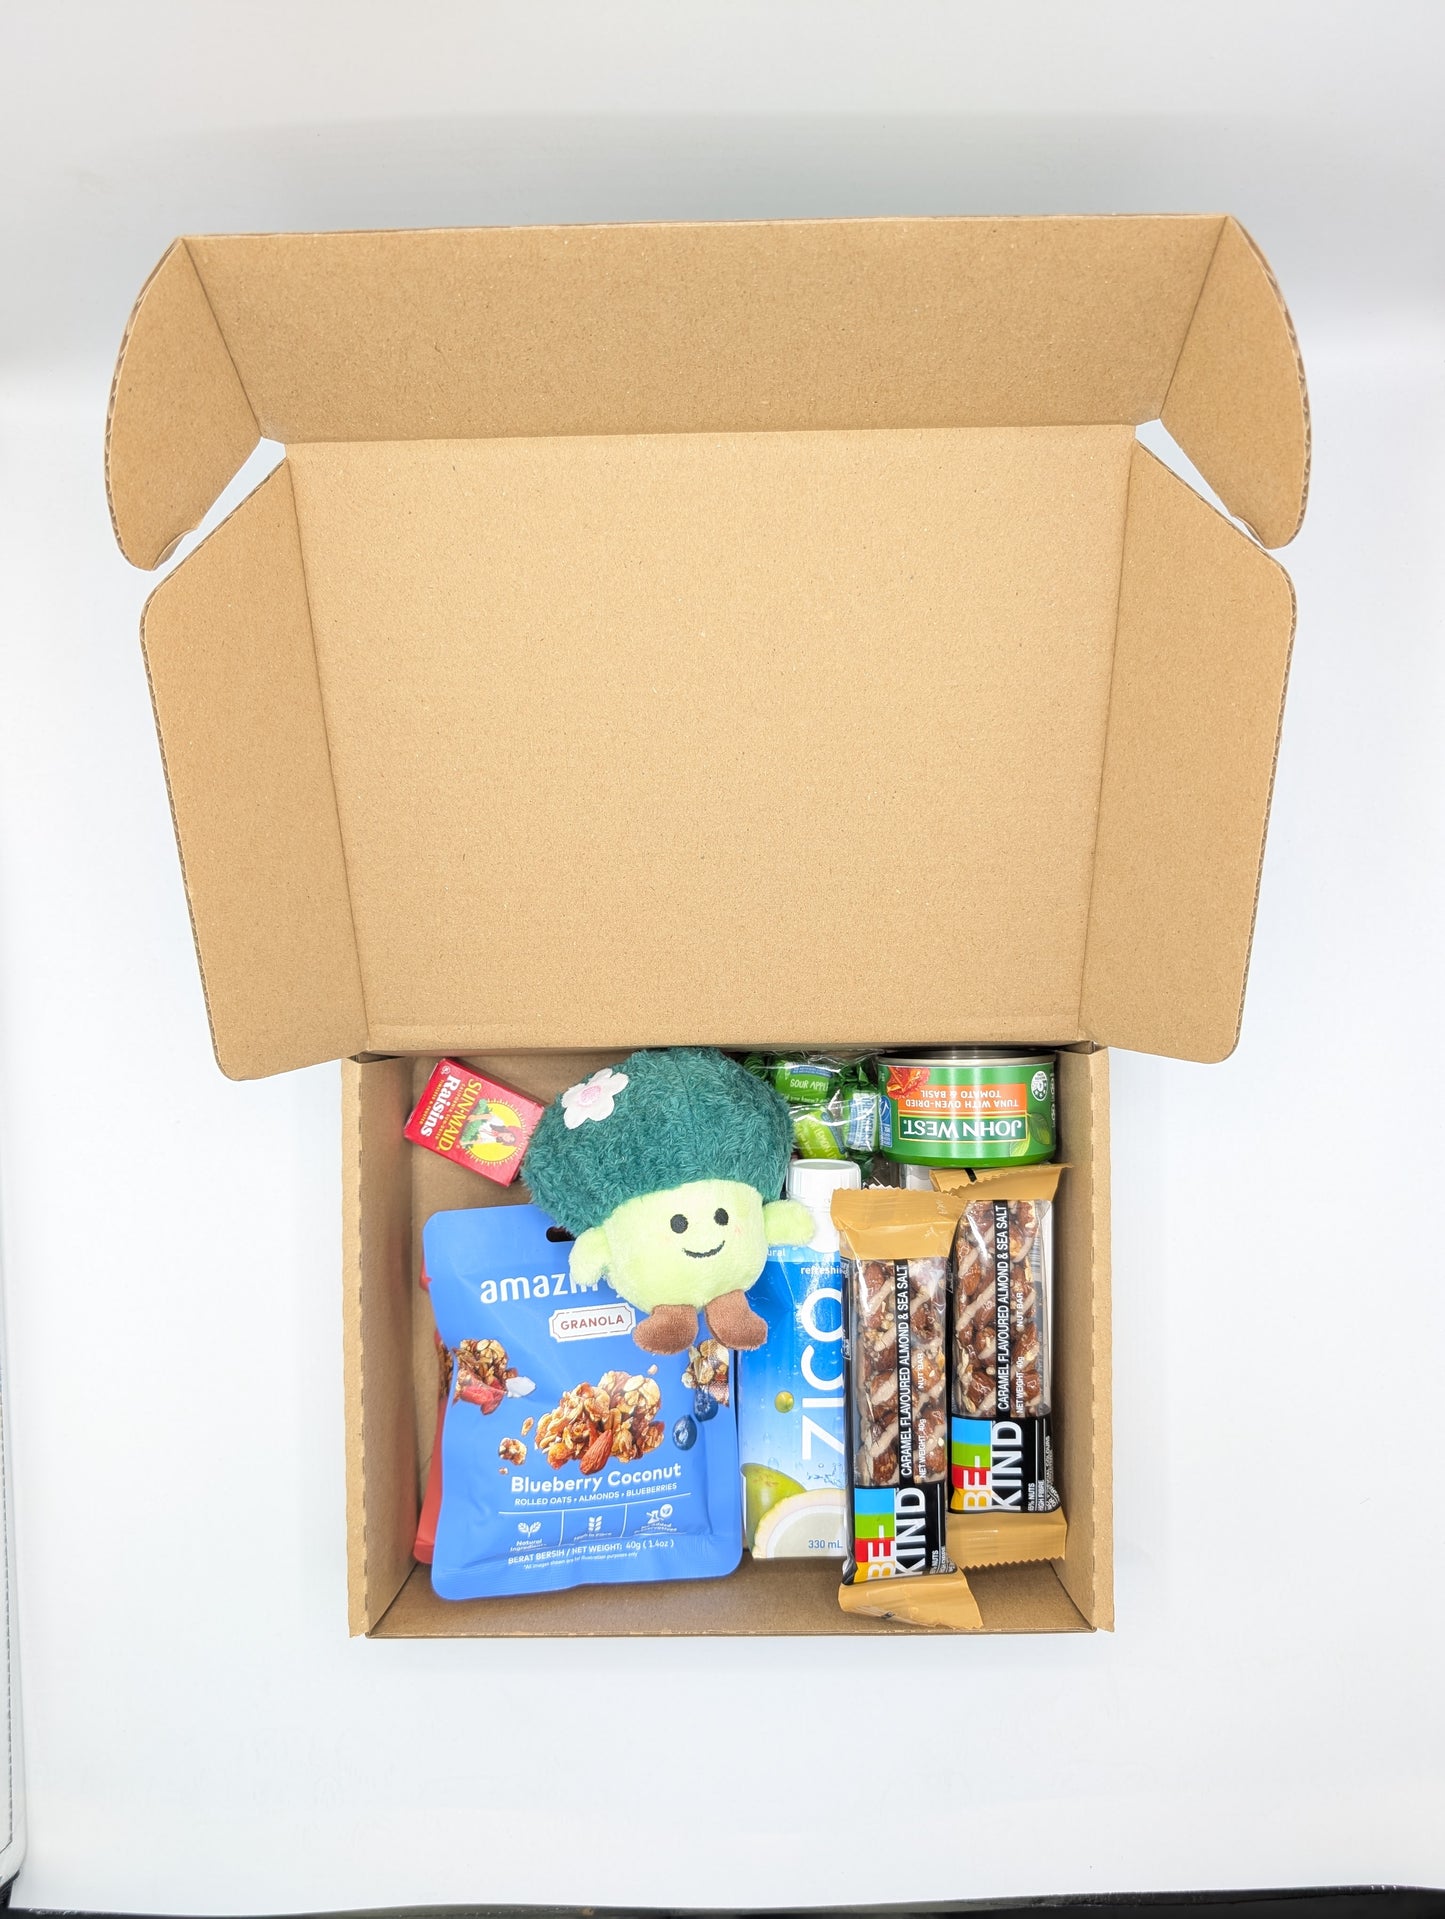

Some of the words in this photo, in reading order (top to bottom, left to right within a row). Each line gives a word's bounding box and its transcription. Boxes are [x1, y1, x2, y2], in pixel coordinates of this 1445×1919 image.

[790, 1079, 809, 1089] SOUR
[921, 1089, 947, 1098] BASIL
[960, 1090, 1001, 1098] TOMATO
[420, 1074, 461, 1137] Raisins
[905, 1100, 962, 1109] OVEN-DRIED
[965, 1100, 991, 1109] WITH
[993, 1100, 1019, 1108] TUNA
[962, 1119, 1023, 1138] JOHN
[996, 1205, 1007, 1228] SALT
[997, 1229, 1008, 1250] SEA
[997, 1252, 1008, 1260] &
[896, 1265, 908, 1290] SALT
[997, 1262, 1009, 1304] ALMOND
[897, 1291, 909, 1311] SEA
[560, 1314, 625, 1331] GRANOLA
[897, 1312, 909, 1320] &
[898, 1321, 910, 1365] ALMOND
[997, 1305, 1009, 1362] FLAVOURED
[917, 1352, 925, 1369] BAR
[917, 1370, 925, 1389] NUT
[998, 1363, 1010, 1411] CARAMEL
[899, 1365, 911, 1425] FLAVOURED
[1016, 1399, 1024, 1414] NET
[900, 1426, 912, 1477] CARAMEL
[919, 1464, 927, 1479] NET
[992, 1421, 1023, 1511] KIND
[511, 1475, 603, 1494] Blueberry
[607, 1463, 682, 1486] Coconut
[515, 1497, 549, 1506] ROLLED
[549, 1496, 572, 1504] OATS
[578, 1491, 620, 1502] ALMONDS
[626, 1482, 678, 1497] BLUEBERRIES
[896, 1487, 926, 1576] KIND
[508, 1554, 535, 1564] BERAT
[535, 1550, 565, 1560] BERSIH
[572, 1546, 588, 1555] NET
[588, 1543, 623, 1552] WEIGHT:
[626, 1540, 641, 1550] 40g
[808, 1539, 825, 1549] 330
[827, 1539, 844, 1549] mL
